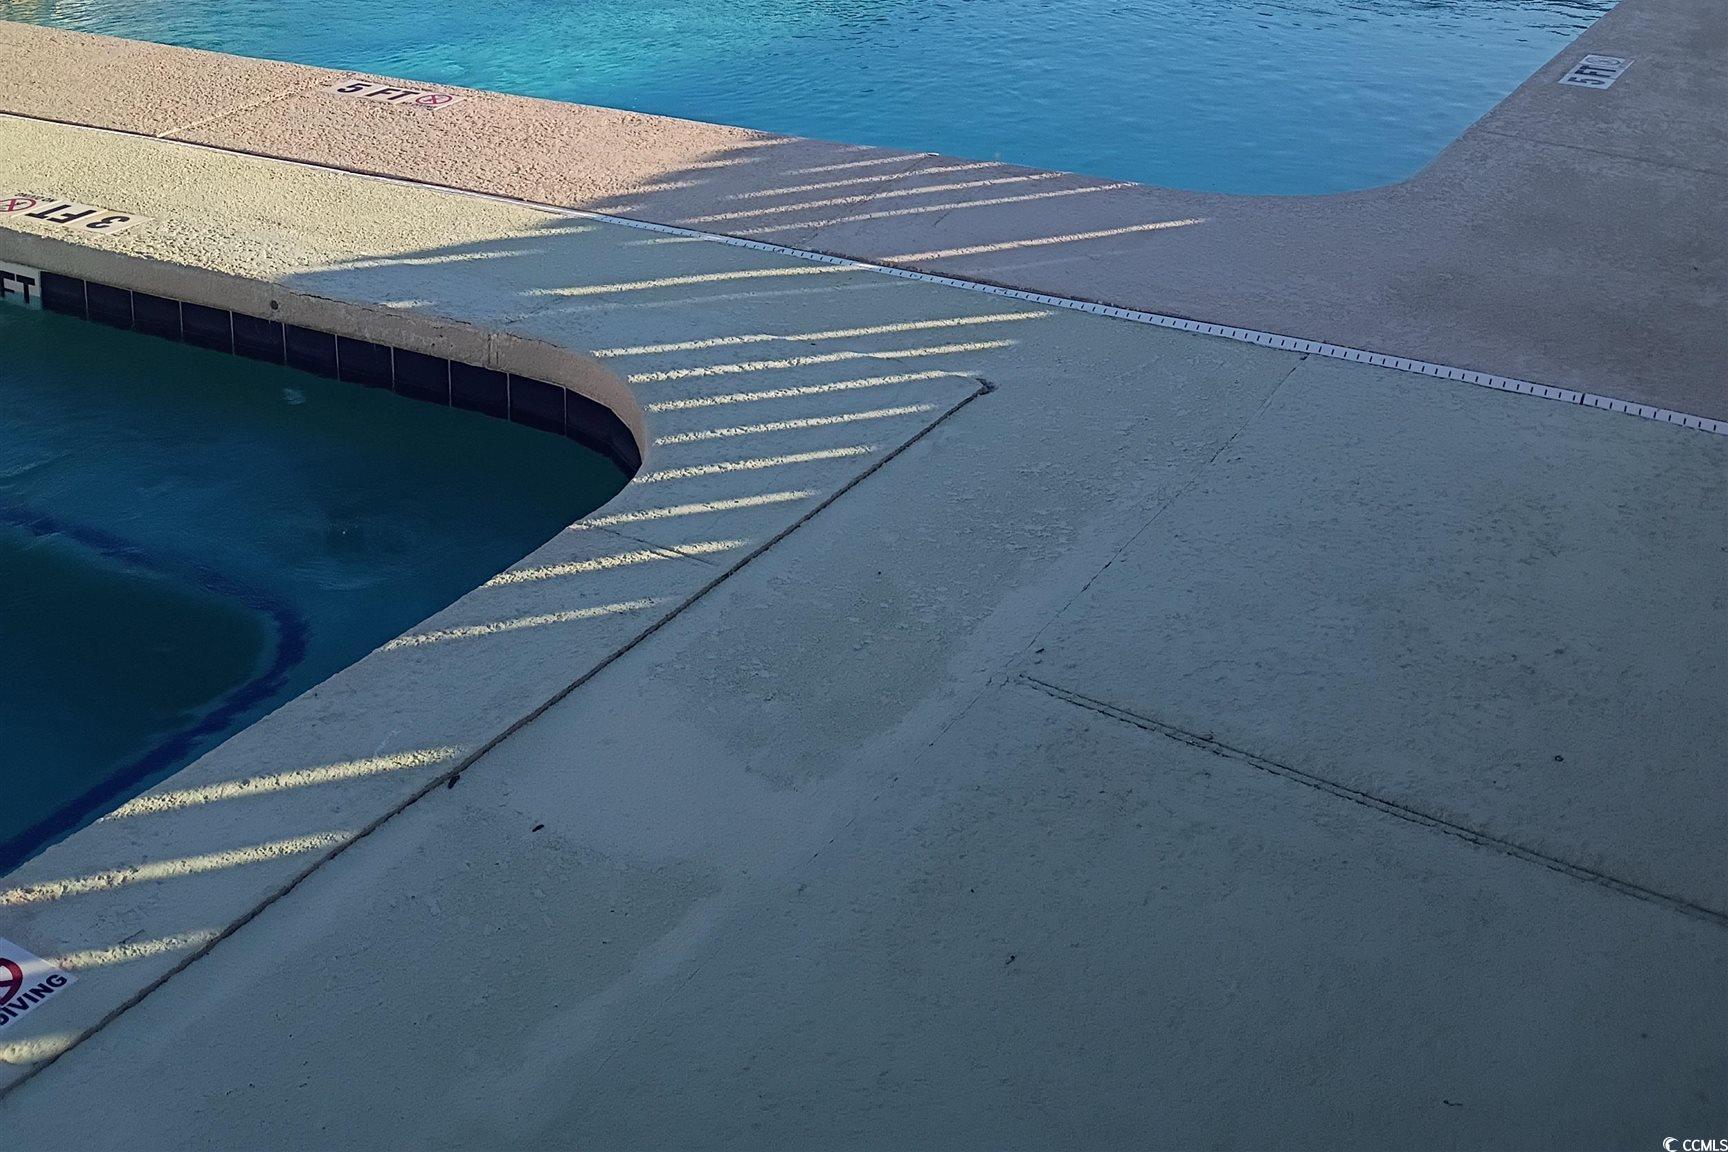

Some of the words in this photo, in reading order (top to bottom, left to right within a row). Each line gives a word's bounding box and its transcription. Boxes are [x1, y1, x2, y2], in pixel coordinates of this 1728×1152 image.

[1574, 64, 1617, 78] FT
[1567, 76, 1606, 86] 5
[336, 82, 372, 93] 5
[364, 87, 421, 101] FT
[24, 203, 98, 224] FT
[86, 215, 131, 229] 3
[0, 269, 36, 304] FT
